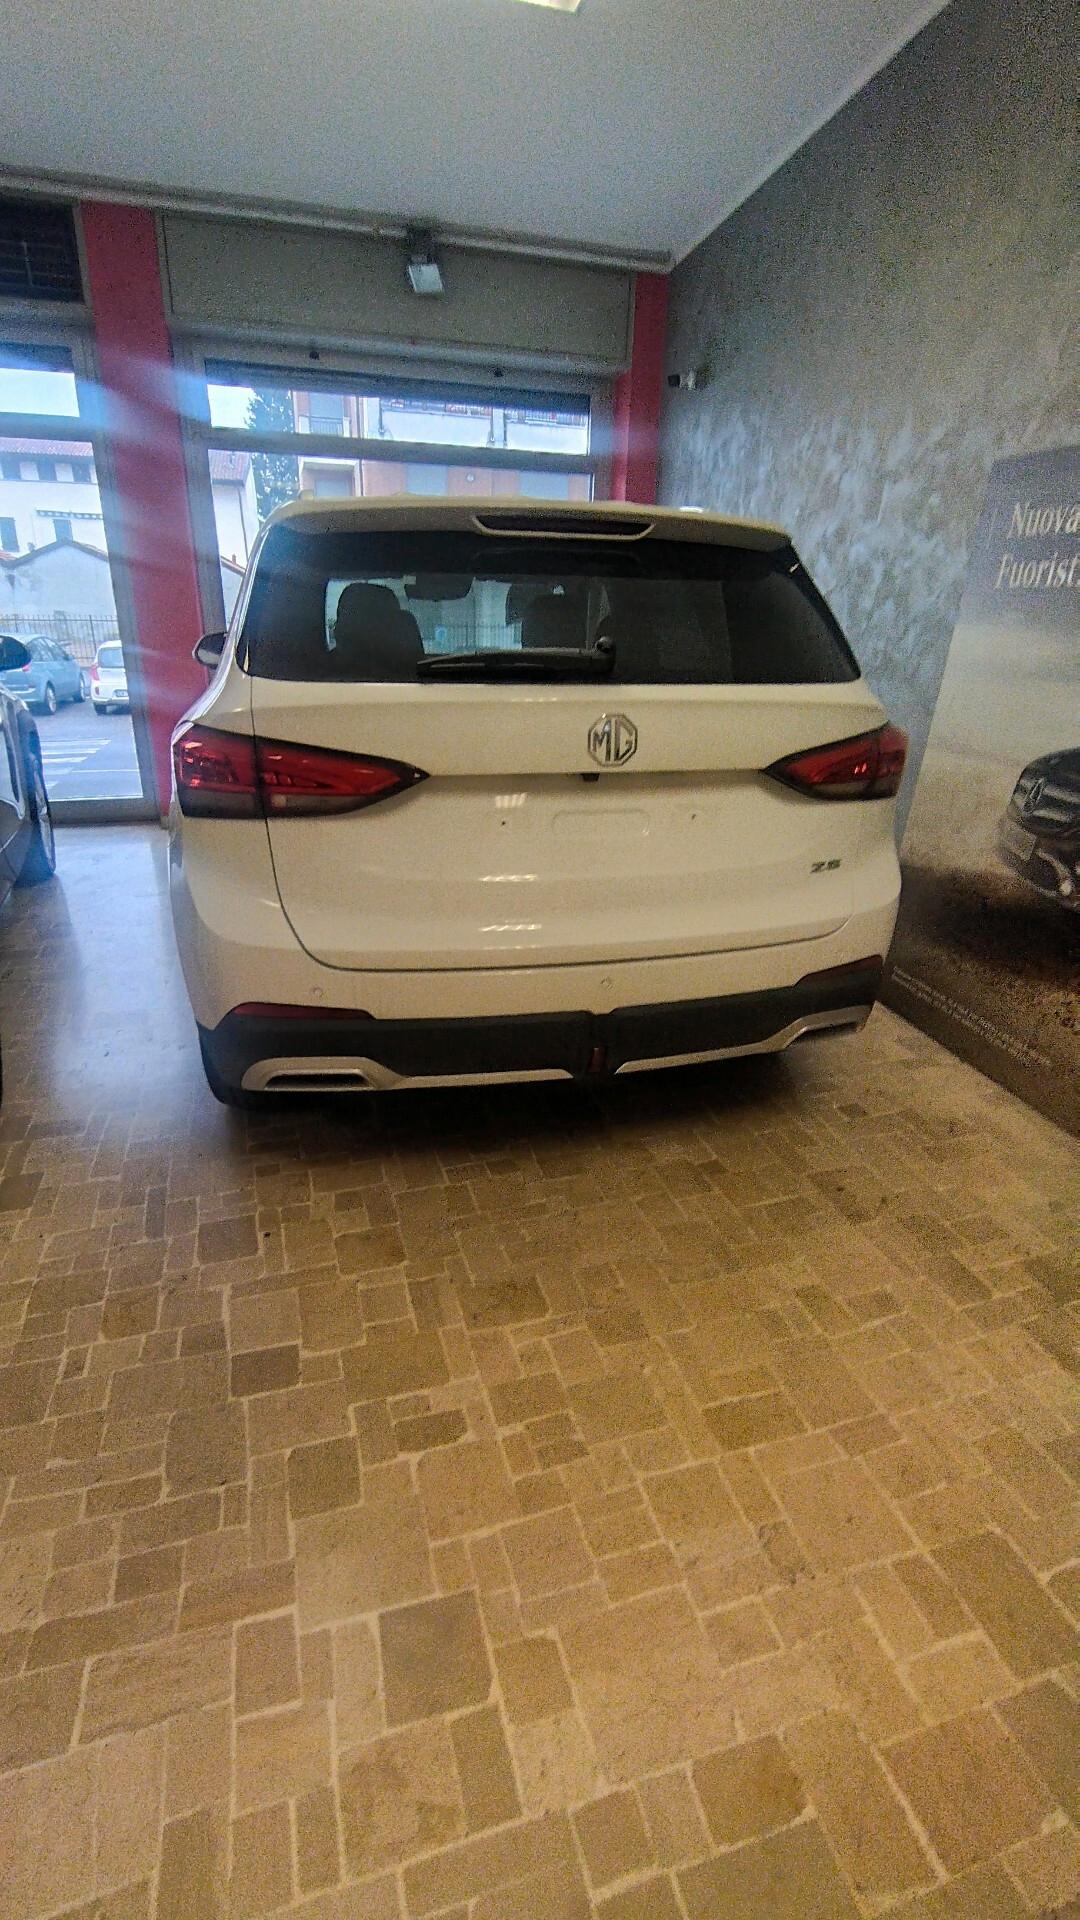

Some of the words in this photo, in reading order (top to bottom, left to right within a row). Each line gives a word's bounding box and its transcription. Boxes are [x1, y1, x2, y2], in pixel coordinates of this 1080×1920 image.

[1006, 499, 1080, 540] Nuova
[993, 551, 1080, 591] Fuorist
[590, 717, 635, 763] MG
